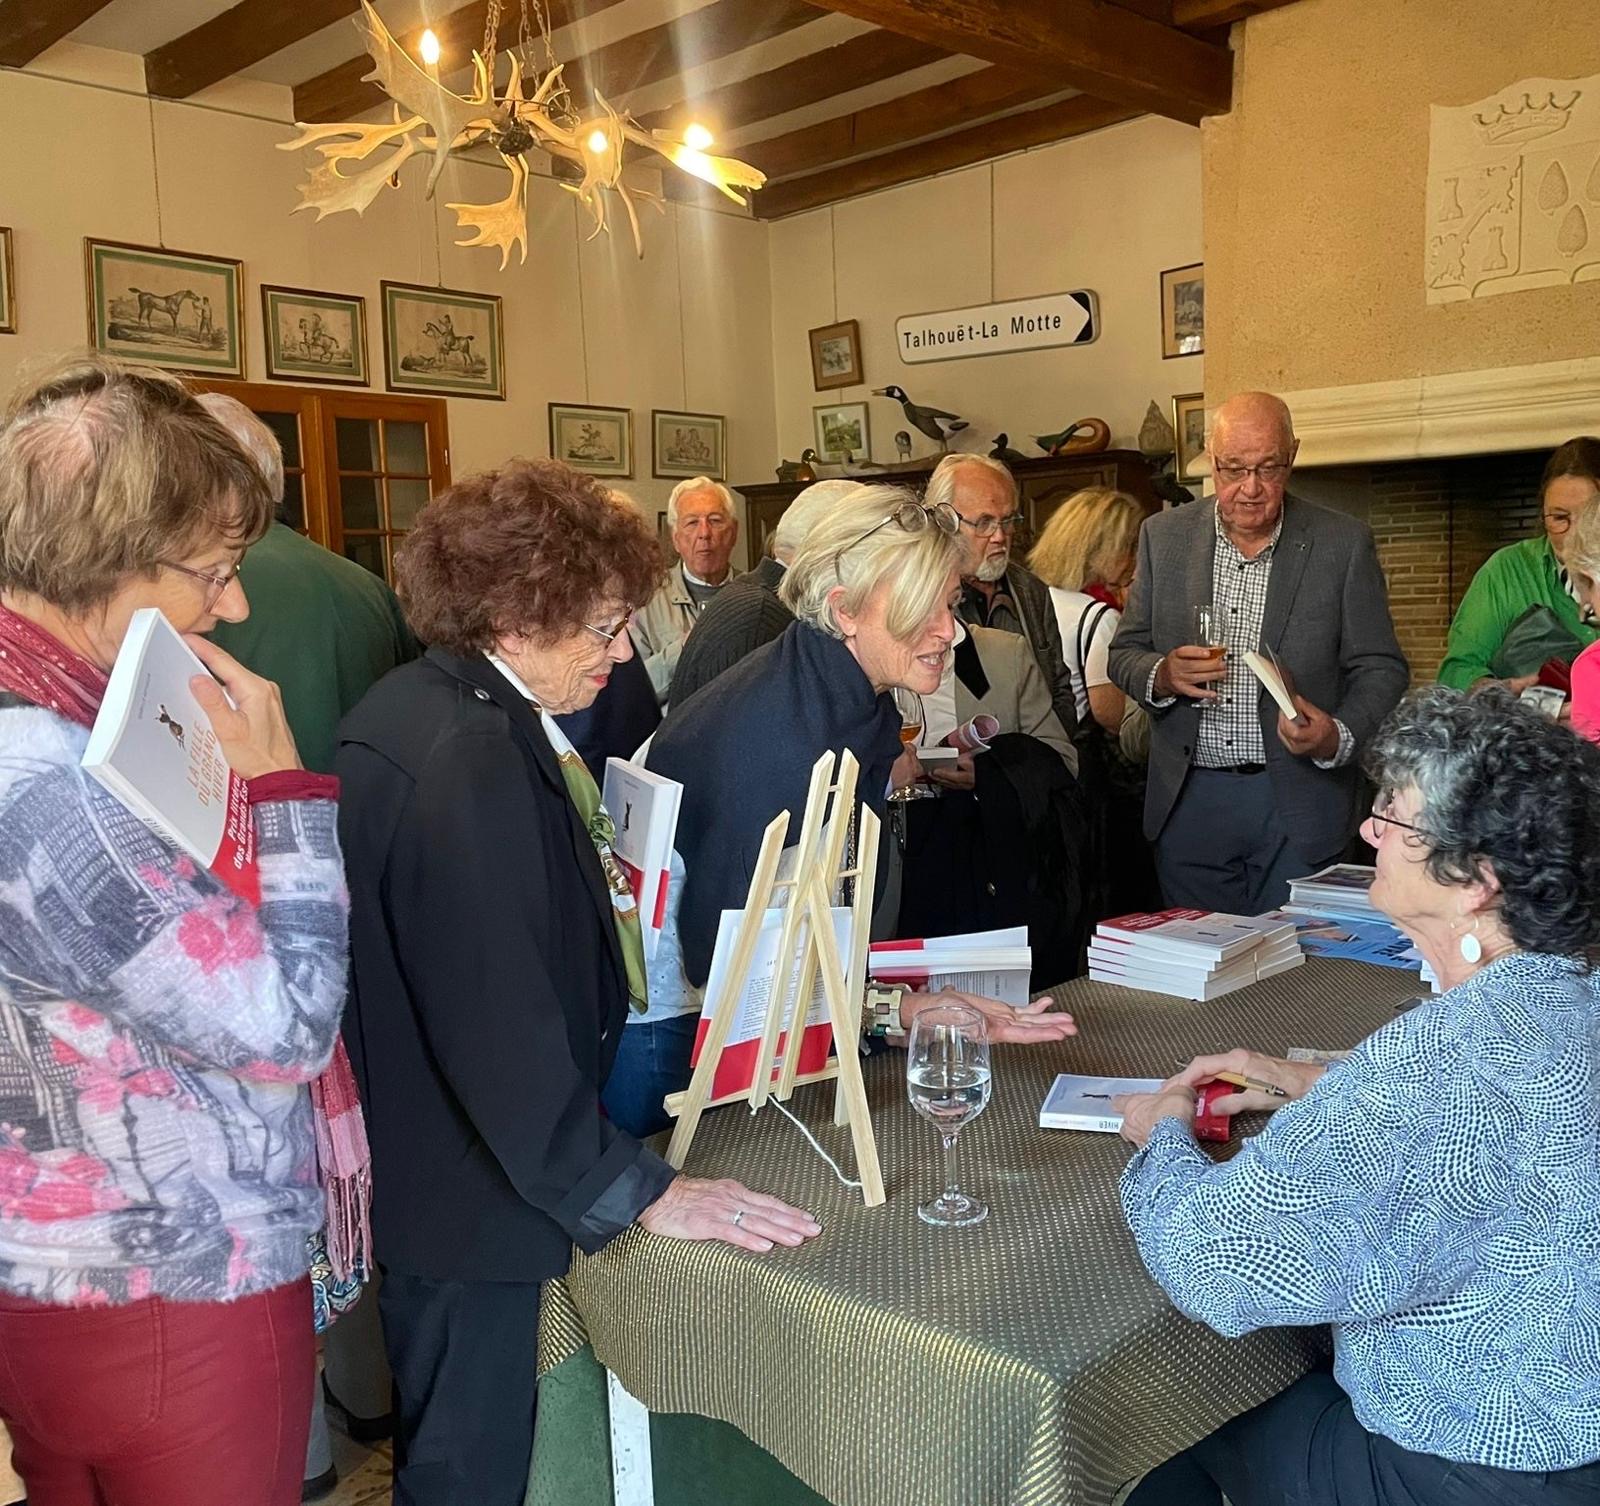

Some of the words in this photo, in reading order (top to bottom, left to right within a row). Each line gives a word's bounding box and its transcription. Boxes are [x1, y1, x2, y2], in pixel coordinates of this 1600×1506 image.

[904, 321, 999, 348] Talhouët-La
[1011, 315, 1061, 335] Motte
[190, 720, 204, 761] FILLE
[200, 730, 216, 781] GRAND
[187, 765, 200, 788] LA
[212, 758, 225, 804] HIVER
[198, 783, 211, 807] DU
[228, 815, 240, 841] Prix
[237, 802, 248, 845] Grands
[233, 845, 246, 870] des
